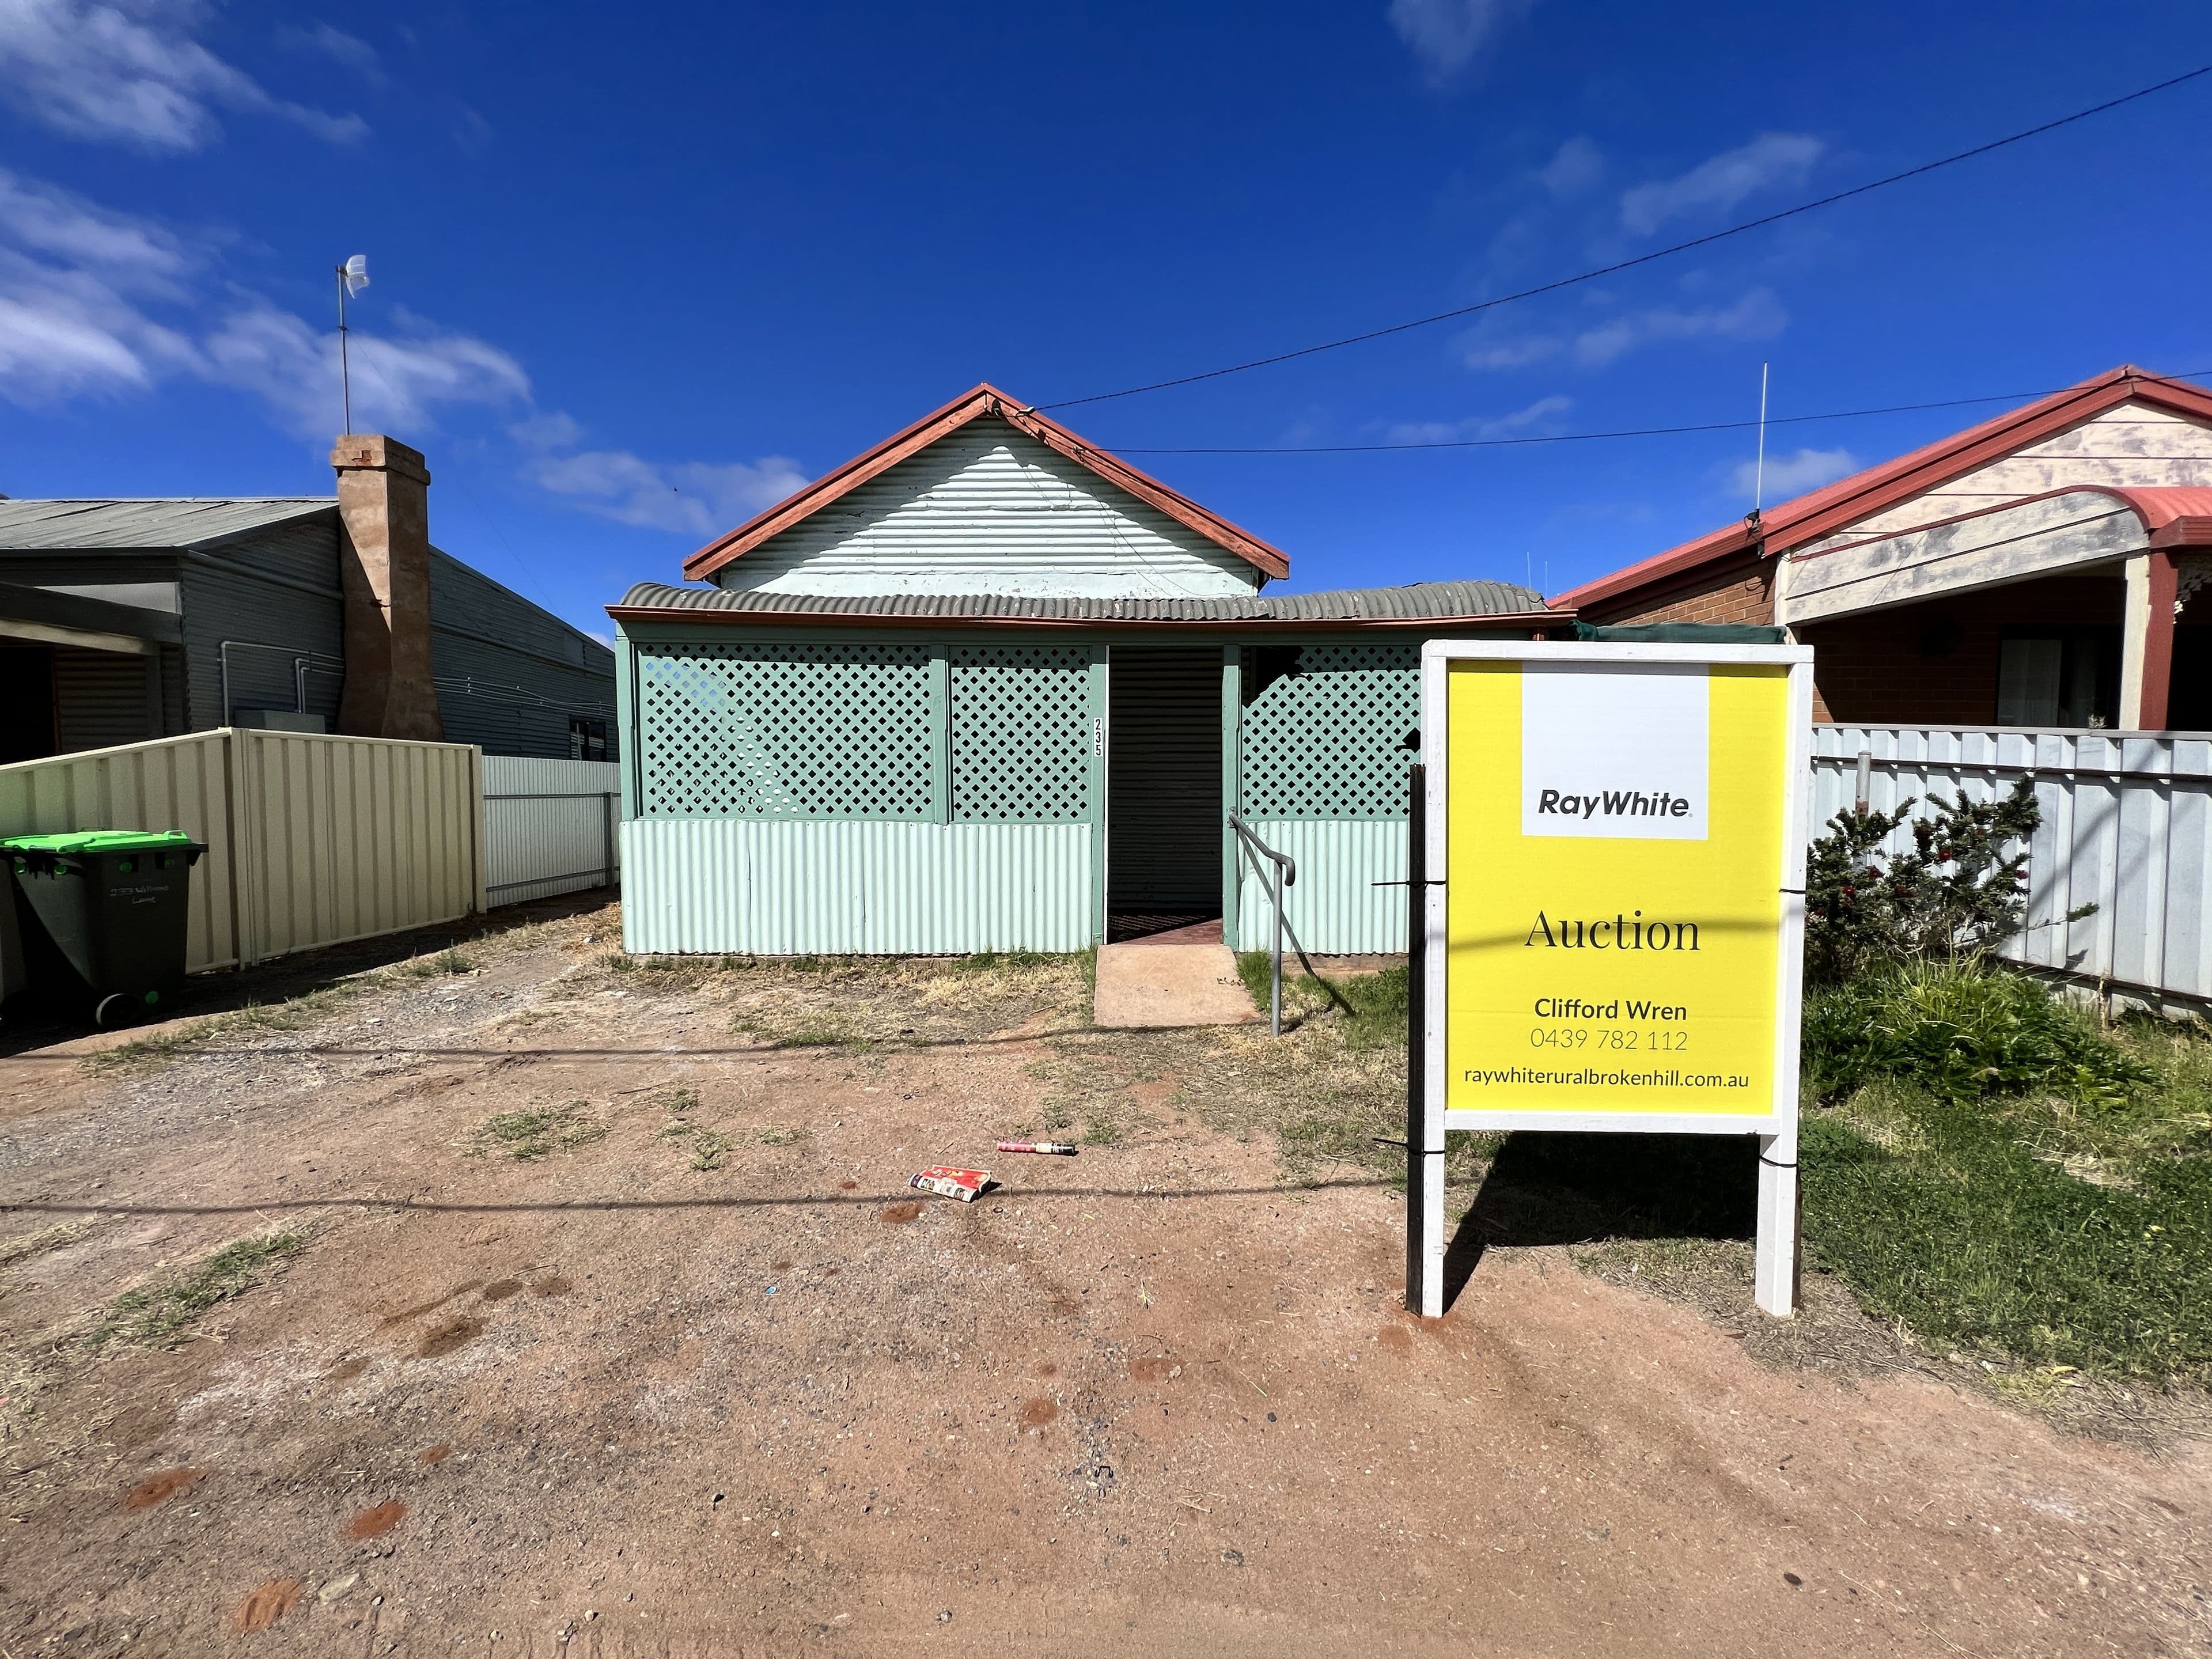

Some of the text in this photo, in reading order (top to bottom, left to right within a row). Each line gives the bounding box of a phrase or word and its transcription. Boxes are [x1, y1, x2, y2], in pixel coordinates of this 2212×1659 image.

[1524, 910, 1701, 952] Auction
[1534, 997, 1688, 1021] Clifford Wren
[1530, 1028, 1688, 1051] 0439 782 112
[1464, 1066, 1750, 1088] raywhiteruralbrokenhill.com.au
